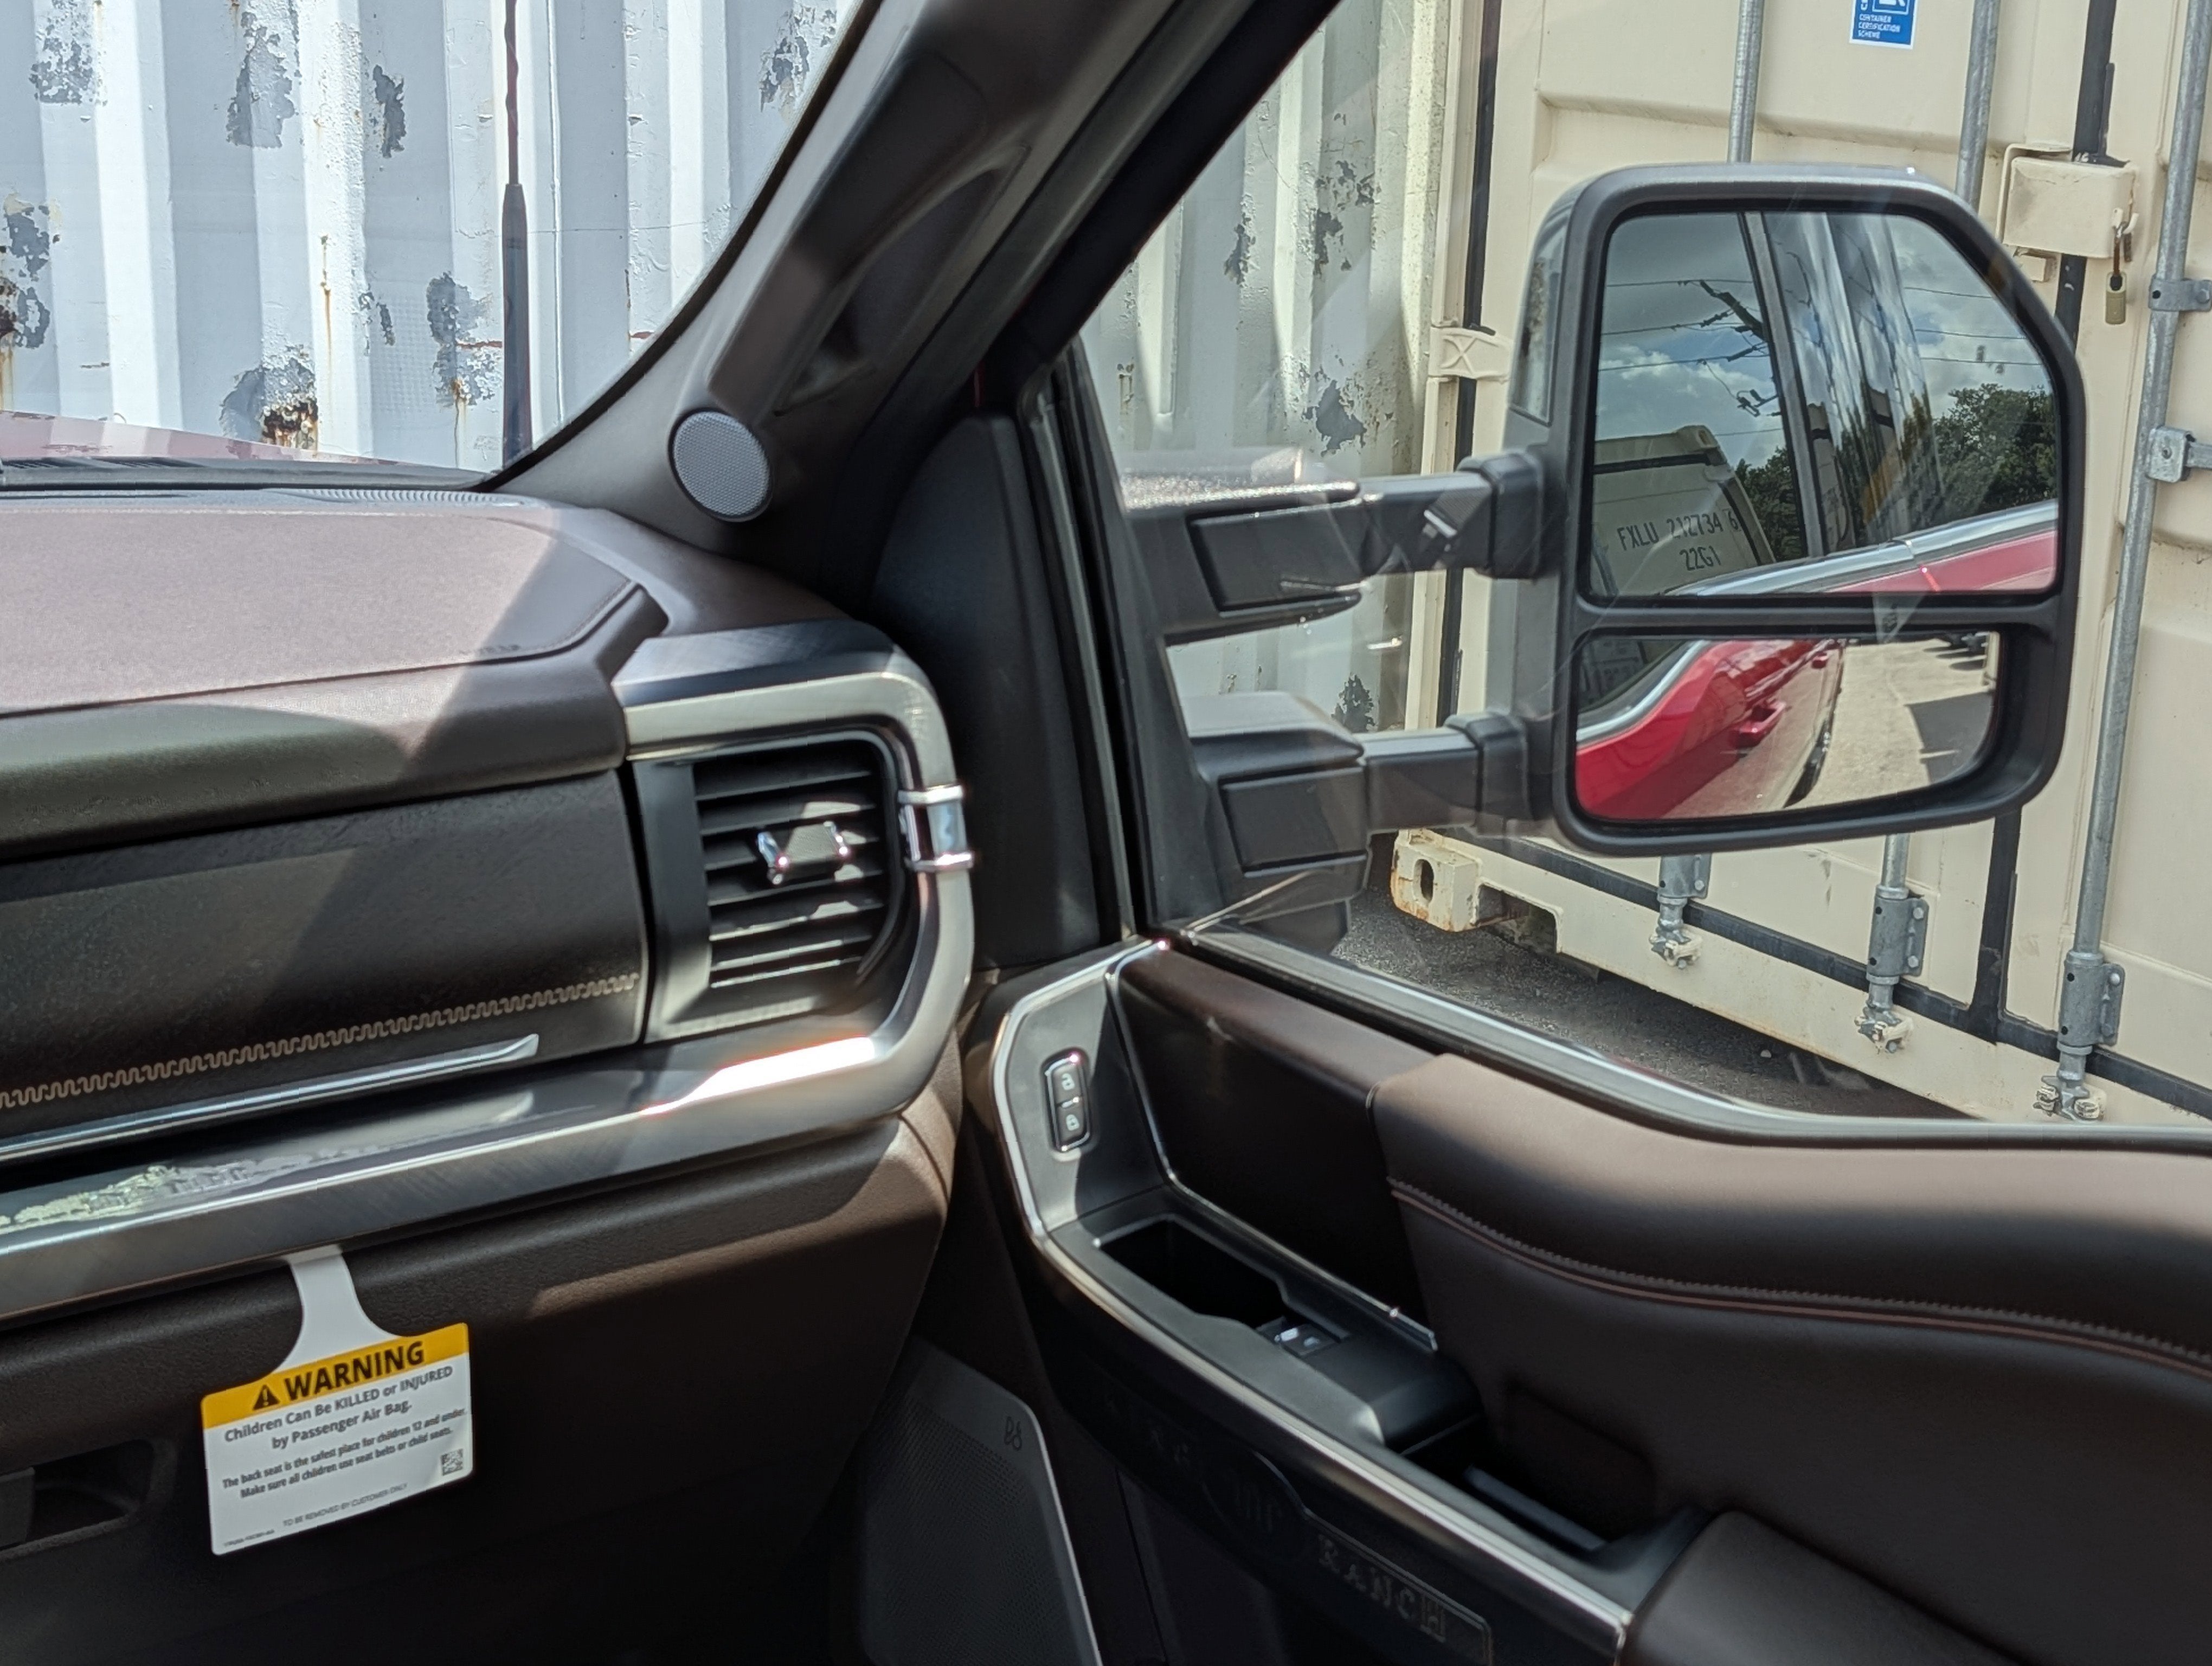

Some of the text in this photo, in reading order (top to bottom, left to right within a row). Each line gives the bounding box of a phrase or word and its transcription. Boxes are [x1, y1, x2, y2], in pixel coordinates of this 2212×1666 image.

[1616, 512, 1738, 551] FXLU 212734 6
[1680, 545, 1722, 572] 22G1
[285, 1342, 423, 1400] WARNING
[224, 1366, 453, 1442] Children Can Be KILLED or INJURED
[272, 1400, 412, 1450] by Passenger Air Bag.
[223, 1408, 465, 1488] The back seat is the safest place for children 12 and under.
[241, 1427, 453, 1498] Make sure all children use seat belts or child seats.
[1318, 1533, 1446, 1643] RANCH
